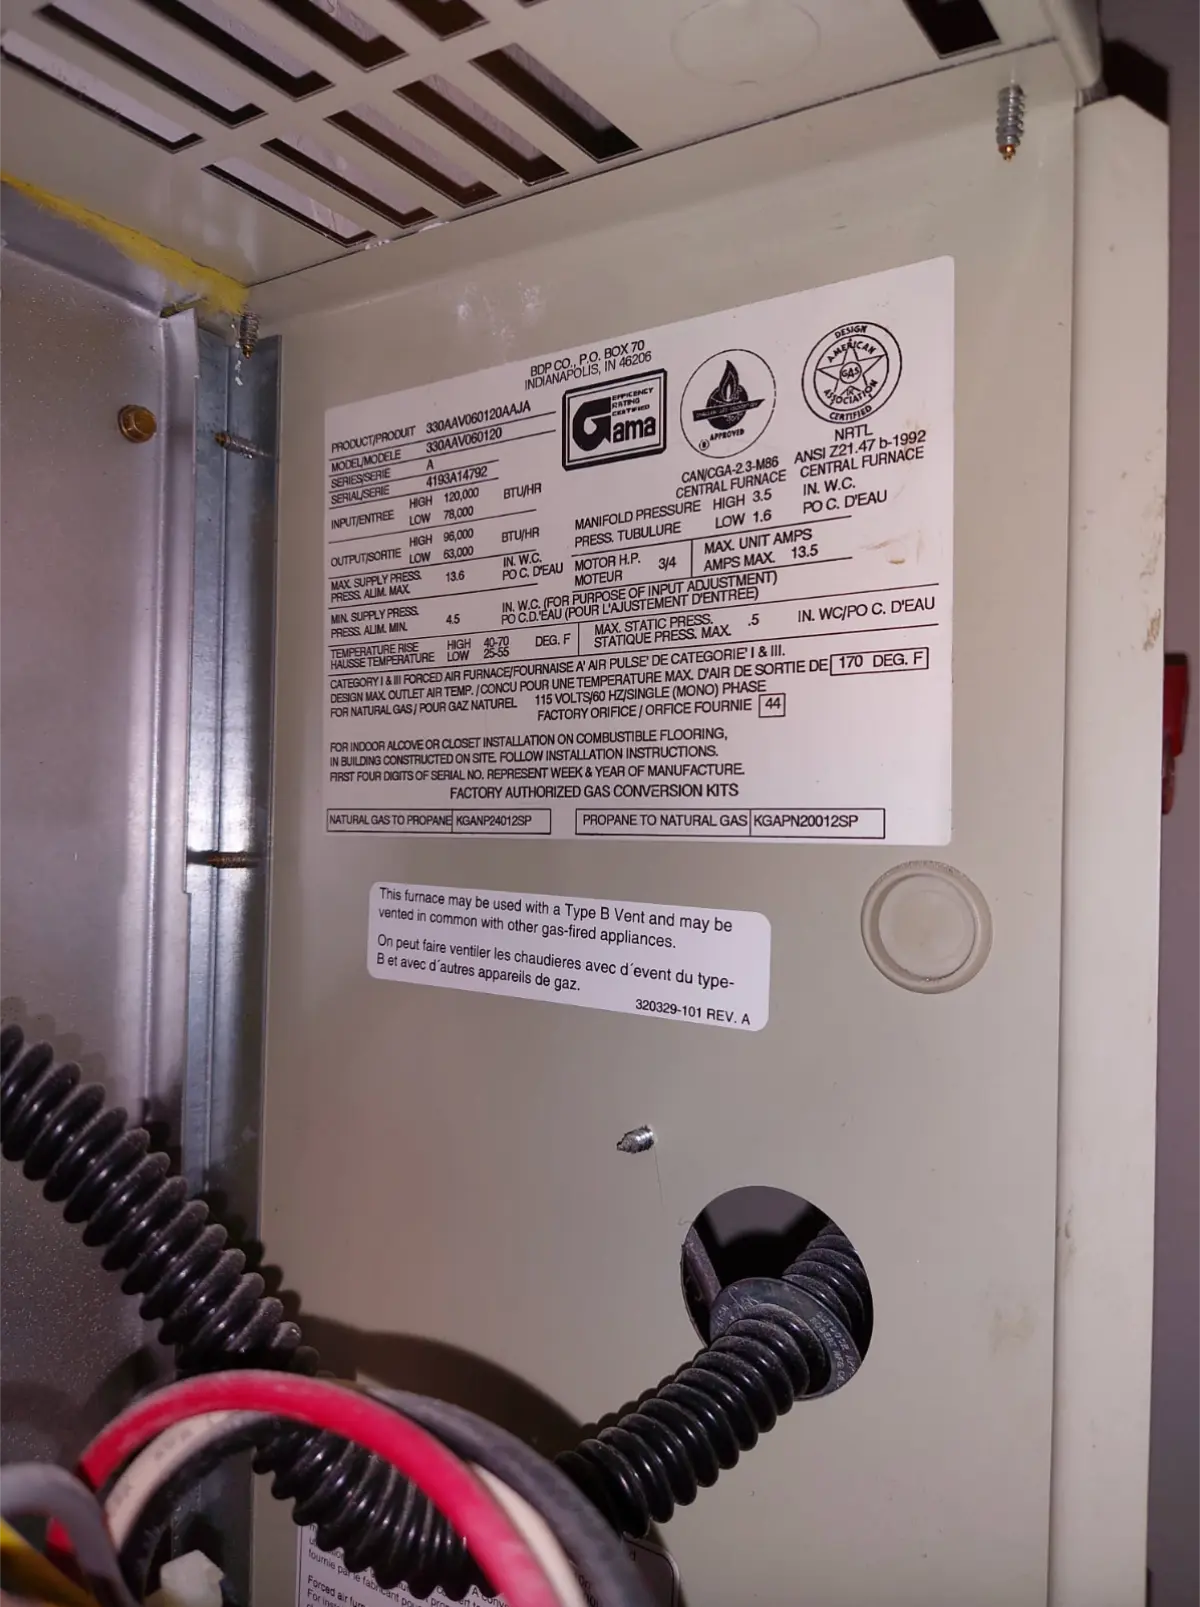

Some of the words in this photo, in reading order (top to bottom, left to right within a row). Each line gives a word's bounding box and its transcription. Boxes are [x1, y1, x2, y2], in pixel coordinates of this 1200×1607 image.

[834, 325, 868, 339] DESIGN
[530, 362, 552, 377] BDP
[554, 358, 576, 371] CO.,
[579, 351, 601, 365] P.O.
[604, 343, 629, 360] BOX
[630, 339, 644, 353] 70
[827, 341, 876, 363] AMERICAN
[525, 363, 601, 390] INDIANAPOLIS,
[604, 359, 616, 372] IN
[619, 351, 652, 369] 46206
[841, 367, 860, 379] GAS
[829, 405, 872, 420] CERTIFIED
[331, 426, 416, 453] PRODUCT/PRODUIT
[426, 400, 531, 434] 330AAV060120AAJA
[710, 428, 745, 441] APPROVED
[835, 424, 874, 441] NRTL
[331, 450, 401, 472] MODEL/MODELE
[426, 427, 502, 453] 330AAV060120
[794, 448, 826, 464] ANSI
[829, 438, 876, 458] Z21.47
[879, 430, 926, 449] b-1992
[331, 468, 391, 489] SERIES/SERIE
[426, 459, 434, 470] A
[800, 457, 858, 478] CENTRAL
[862, 446, 924, 468] FURNACE
[331, 485, 390, 505] SERIAL/SERIE
[426, 465, 488, 488] 4193A14792
[409, 495, 432, 509] HIGH
[444, 487, 479, 503] 120,000
[504, 483, 542, 499] BTU/HR
[676, 480, 727, 499] CENTRAL
[730, 469, 787, 490] FURNACE
[575, 511, 633, 530] MANIFOLD
[636, 500, 701, 521] PRESSURE
[713, 494, 745, 510] HIGH
[752, 488, 772, 502] 3.5
[803, 482, 820, 496] IN.
[824, 477, 855, 492] W.C.
[331, 510, 394, 529] INPUT/ENTREE
[409, 513, 431, 526] LOW
[443, 505, 474, 520] 78,000
[575, 532, 614, 548] PRESS.
[617, 522, 682, 542] TUBULURE
[715, 513, 746, 529] LOW
[753, 509, 772, 523] 1.6
[803, 500, 823, 514] PO
[826, 498, 840, 510] C.
[845, 489, 888, 508] D'EAU
[409, 534, 432, 547] HIGH
[443, 528, 474, 543] 96,000
[502, 527, 540, 543] BTU/HR
[704, 540, 735, 554] MAX.
[739, 533, 770, 550] UNIT
[773, 528, 812, 545] AMPS
[331, 548, 402, 567] OUTPUT/SORTIE
[409, 551, 431, 564] LOW
[443, 546, 474, 560] 63,000
[575, 555, 616, 571] MOTOR
[619, 552, 641, 565] H.P.
[658, 556, 677, 571] 3/4
[704, 556, 740, 572] AMPS
[744, 551, 775, 566] MAX.
[791, 544, 819, 558] 13.5
[575, 570, 623, 586] MOTEUR
[798, 609, 815, 622] IN.
[819, 605, 868, 621] WC/PO
[871, 603, 886, 615] C.
[891, 596, 935, 613] D'EAU
[594, 622, 619, 635] MAX.
[624, 618, 667, 632] STATIC
[670, 614, 713, 628] PRESS.
[594, 633, 651, 647] STATIQUE
[654, 629, 697, 642] PRESS.
[701, 624, 731, 639] MAX.
[748, 614, 759, 626] .5
[330, 757, 338, 766] IN
[341, 756, 381, 766] BUILDING
[383, 754, 454, 765] CONSTRUCTED
[455, 753, 470, 763] ON
[473, 752, 497, 763] SITE.
[500, 751, 543, 762] FOLLOW
[546, 748, 624, 761] INSTALLATION
[626, 745, 718, 759] INSTRUCTIONS.
[450, 787, 502, 799] FACTORY
[505, 786, 581, 799] AUTHORIZED
[584, 785, 610, 798] GAS
[614, 784, 702, 798] CONVERSION
[706, 783, 739, 797] KITS
[329, 814, 370, 825] NATURAL
[371, 815, 391, 825] GAS
[392, 815, 405, 825] TO
[407, 815, 452, 826] PROPANE
[456, 815, 532, 826] KGANP24012SP
[583, 815, 638, 826] PROPANE
[639, 815, 656, 826] TO
[660, 815, 717, 826] NATURAL
[720, 815, 747, 827] GAS
[753, 815, 858, 827] KGAPN20012SP
[380, 887, 401, 901] This
[404, 889, 445, 904] furnace
[448, 896, 471, 910] may
[475, 896, 489, 908] be
[493, 898, 522, 912] used
[525, 901, 549, 914] with
[553, 905, 560, 915] a
[565, 903, 596, 921] Type
[600, 906, 610, 920] B
[614, 908, 645, 923] Vent
[649, 913, 675, 927] and
[680, 916, 709, 933] may
[714, 917, 732, 932] be
[379, 908, 414, 921] vented
[417, 910, 426, 922] in
[429, 912, 477, 927] common
[481, 917, 503, 929] with
[508, 920, 538, 934] other
[542, 924, 596, 939] gas-fired
[600, 930, 676, 948] appliances.
[377, 934, 393, 947] On
[396, 938, 420, 951] peut
[422, 938, 446, 953] faire
[450, 944, 491, 958] ventiler
[494, 947, 510, 961] les
[514, 950, 581, 970] chaudieres
[585, 961, 616, 974] avec
[675, 970, 693, 984] du
[698, 972, 734, 990] type-
[377, 953, 384, 964] B
[388, 956, 397, 966] et
[400, 958, 426, 970] avec
[478, 966, 531, 984] appareils
[535, 974, 550, 986] de
[554, 976, 580, 992] gaz.
[635, 999, 701, 1017] 320329-101
[706, 1009, 737, 1023] REV.
[741, 1013, 750, 1025] A
[307, 1588, 321, 1601] For
[308, 1574, 335, 1596] Forced
[337, 1592, 347, 1603] air
